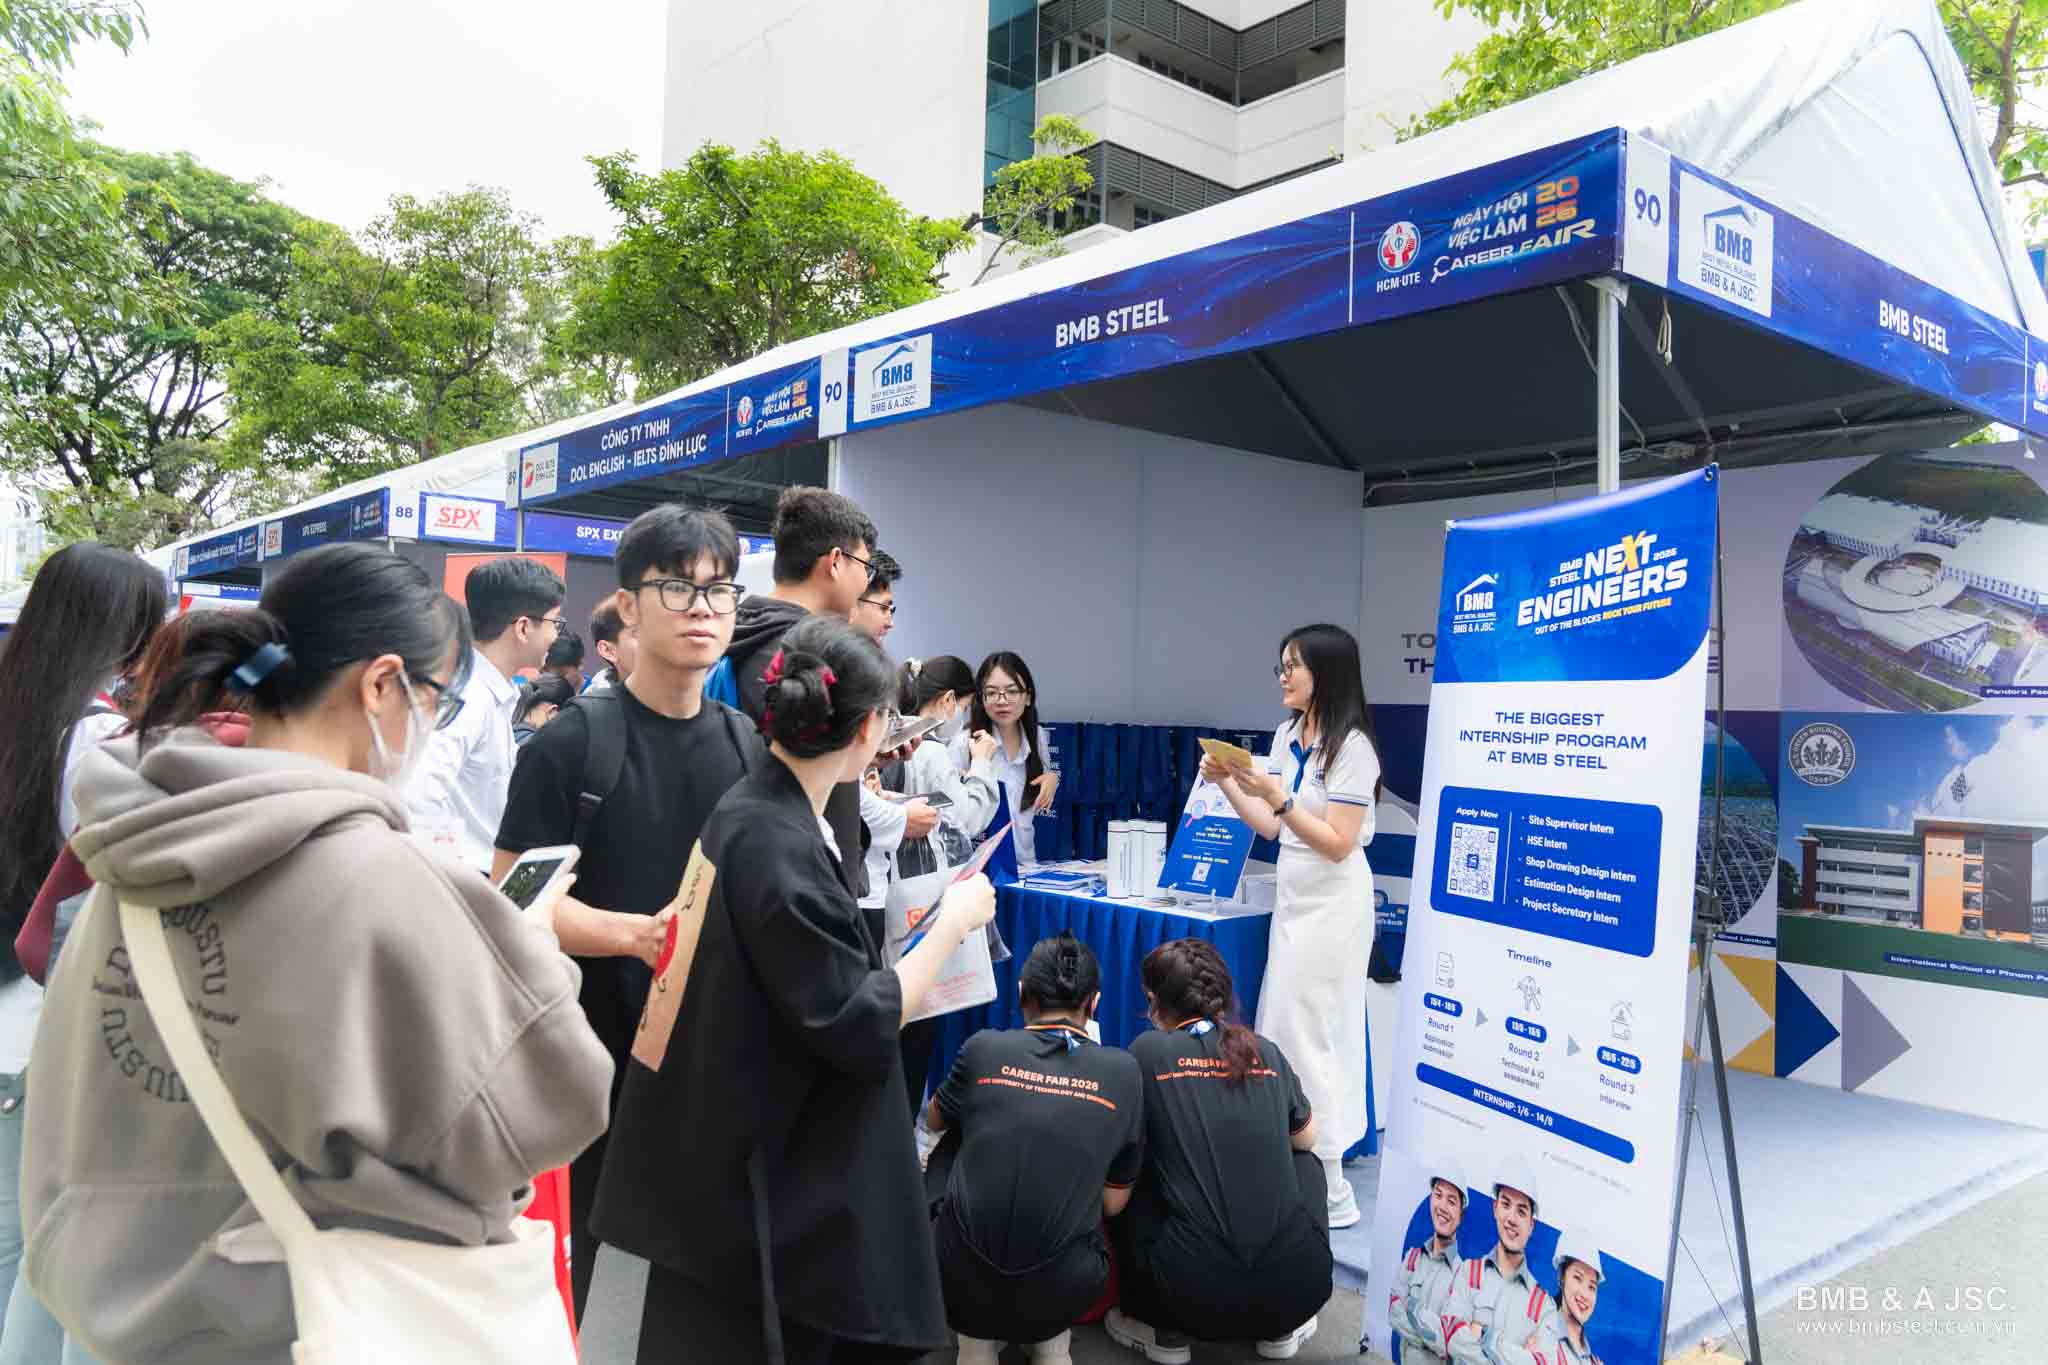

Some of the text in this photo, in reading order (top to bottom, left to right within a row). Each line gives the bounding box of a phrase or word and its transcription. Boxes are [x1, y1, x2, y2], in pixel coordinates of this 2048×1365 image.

[1536, 176, 1579, 204] 20
[1453, 191, 1528, 230] NGÀY HỘI
[1536, 200, 1578, 229] 26
[1634, 188, 1661, 226] 90
[1449, 213, 1528, 249] VIỆC LÀM
[1430, 218, 1599, 283] CAREER FAIR
[1715, 223, 1752, 265] BMB
[1701, 267, 1720, 291] BMB
[1723, 276, 1728, 290] &
[1730, 281, 1736, 296] A
[1055, 298, 1169, 348] BMB STEEL
[1879, 299, 1950, 355] BMB STEEL
[881, 361, 913, 387] BMB
[824, 382, 842, 403] 90
[871, 401, 886, 414] BMB
[601, 417, 670, 451] CÔNG TY TNHH
[570, 465, 588, 484] DOL
[589, 454, 625, 478] ENGLISH
[633, 447, 657, 468] IELTS
[659, 440, 684, 464] ĐÌNH
[686, 433, 708, 460] LỰC
[395, 506, 413, 519] 88
[439, 506, 481, 529] SPX
[576, 526, 600, 540] SPX
[1560, 558, 1583, 574] BMB
[1584, 530, 1658, 580] NEXT
[1549, 570, 1582, 588] STEEL
[1463, 592, 1494, 611] BMB
[1517, 558, 1688, 627] ENGINEERS
[1453, 623, 1467, 634] BMB
[1468, 623, 1473, 633] &
[1474, 623, 1480, 632] A
[1535, 622, 1548, 635] OUT
[1549, 621, 1559, 632] OF
[1559, 619, 1572, 631] THE
[1573, 613, 1601, 628] BLOCKS
[1495, 711, 1605, 727] THE BIGGEST
[1459, 729, 1647, 751] INTERNSHIP PROGRAM
[1487, 750, 1608, 770] AT BMB STEEL
[1456, 807, 1499, 819] Apply Now
[1528, 815, 1615, 835] Site Supervisor Intern
[1527, 835, 1568, 850] HSE Intern
[1526, 856, 1637, 883] Shop Drawing Design Intern
[1524, 876, 1622, 904] Estimation Design Intern
[1522, 896, 1618, 926] Project Secretary Intern
[1506, 948, 1553, 969] Timeline
[1890, 955, 1947, 969] International
[1949, 963, 1983, 974] School
[1508, 1042, 1540, 1062] Round 2
[1001, 1065, 1045, 1083] CAREER
[1045, 1074, 1070, 1087] FAIR
[1599, 1074, 1635, 1095] Round 3
[1473, 1087, 1517, 1113] INTERNSHIP:
[1517, 1105, 1530, 1118] 1/6
